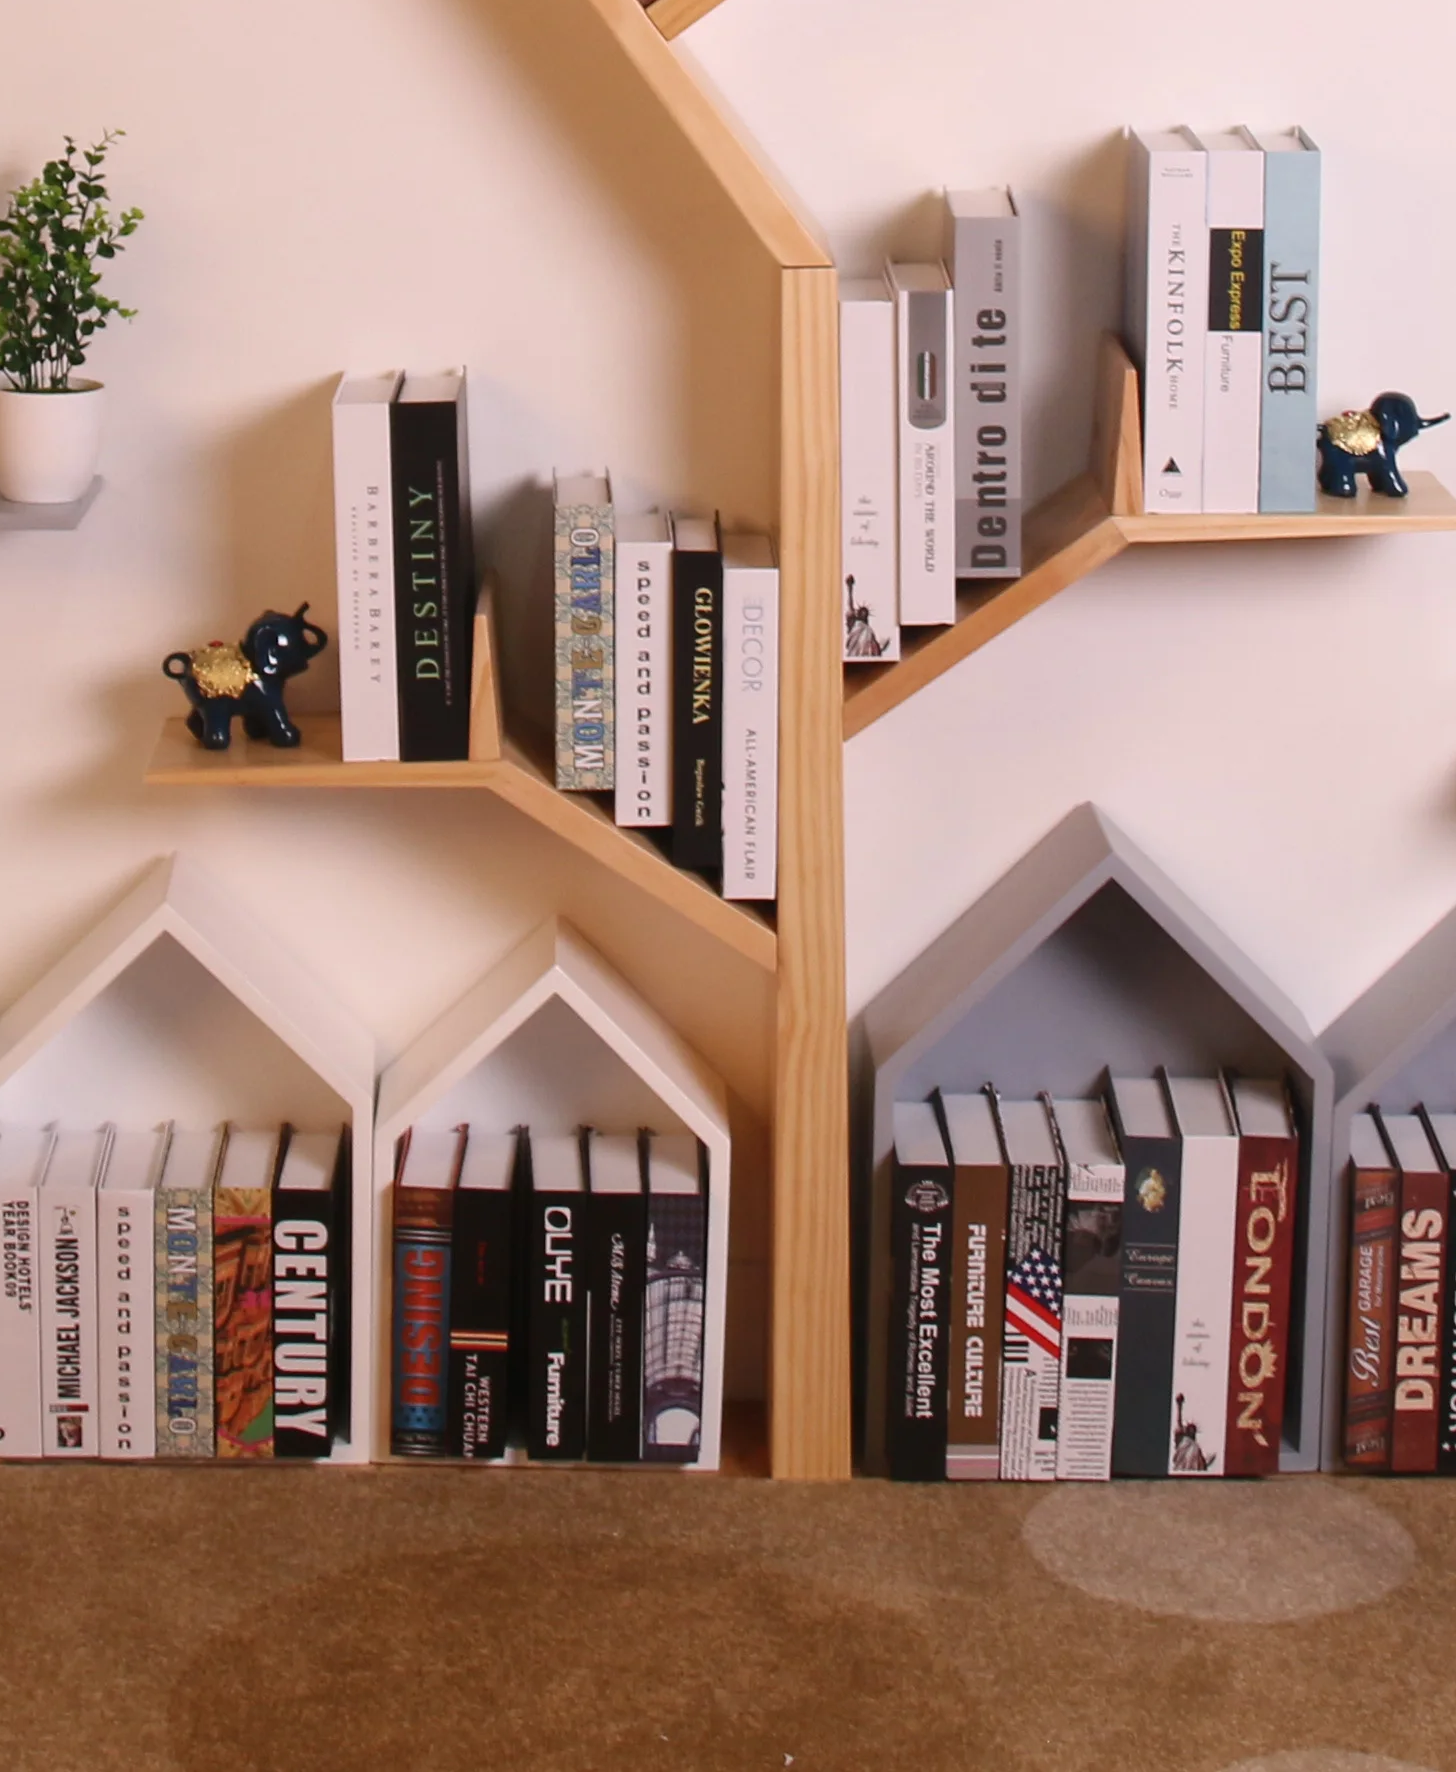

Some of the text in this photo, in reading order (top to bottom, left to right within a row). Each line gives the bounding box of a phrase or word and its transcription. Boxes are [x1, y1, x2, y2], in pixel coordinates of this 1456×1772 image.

[1166, 224, 1185, 411] THE KINFOLK HOME
[1227, 230, 1246, 330] Expo Express
[1268, 261, 1312, 395] BEST
[1220, 335, 1234, 393] Furniture
[970, 309, 1007, 569] Dentro di te
[408, 486, 440, 680] DESTINY
[925, 501, 935, 572] THE WORLD
[571, 646, 607, 771] MONTE
[637, 560, 652, 819] speed and passion
[742, 604, 763, 693] DECOR
[744, 728, 757, 881] ALL-AMERICAN FLAIR
[2, 1201, 16, 1237] YEAR
[16, 1201, 32, 1310] DESIGN HOTELS
[167, 1207, 198, 1322] MONTE
[55, 1237, 82, 1400] MICHAEL JACKSON
[118, 1206, 131, 1450] speed and passion
[273, 1220, 328, 1437] CENTURY
[400, 1250, 443, 1406] DESING
[465, 1354, 478, 1400] TAI CHI
[916, 1223, 941, 1418] The Most Excellent
[964, 1224, 986, 1418] FURNITURE CULTURE
[1351, 1246, 1381, 1388] Best GARAGE
[1395, 1208, 1444, 1412] DREAMS
[478, 1375, 491, 1444] WESTERN
[546, 1352, 566, 1446] Furniture
